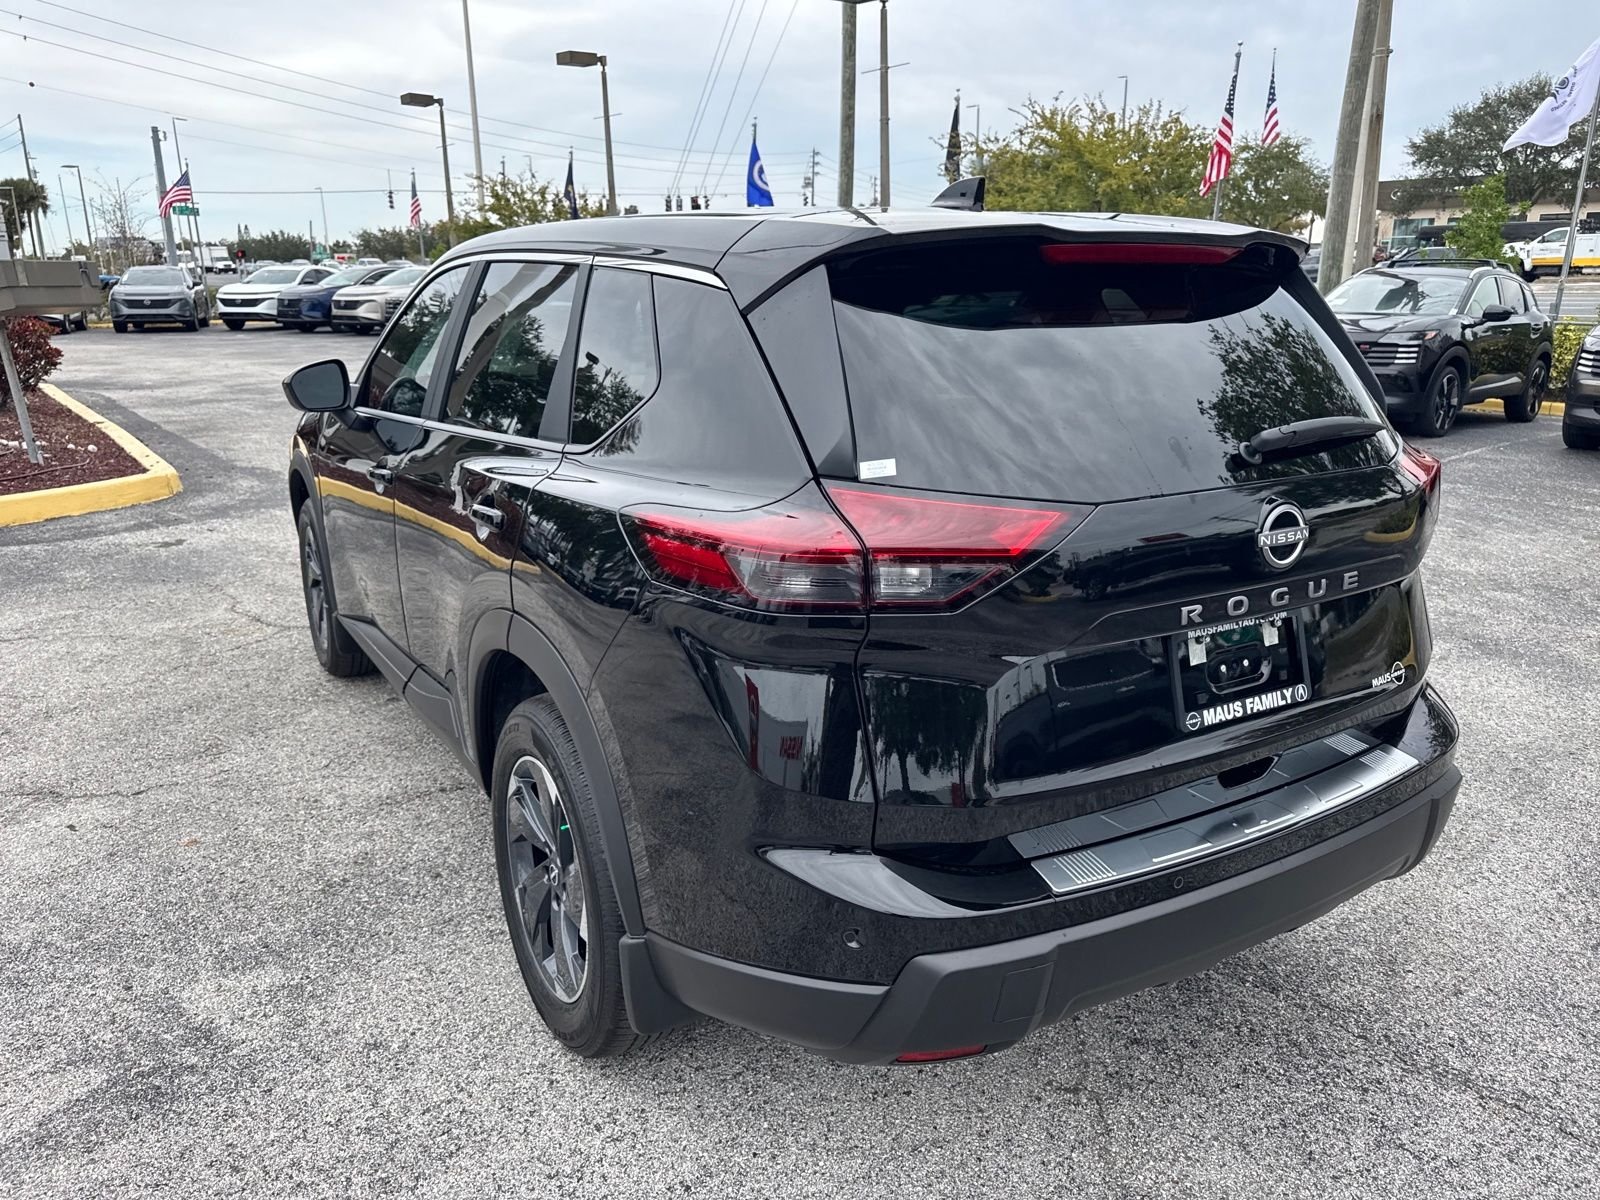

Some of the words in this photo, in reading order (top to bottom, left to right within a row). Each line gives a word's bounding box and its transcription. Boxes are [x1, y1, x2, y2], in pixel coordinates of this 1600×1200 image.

[1260, 528, 1309, 546] NISSAN
[1180, 571, 1359, 626] ROGUE
[1372, 673, 1391, 688] MAUS
[1202, 701, 1244, 726] MAUS
[1245, 687, 1293, 714] FAMILY
